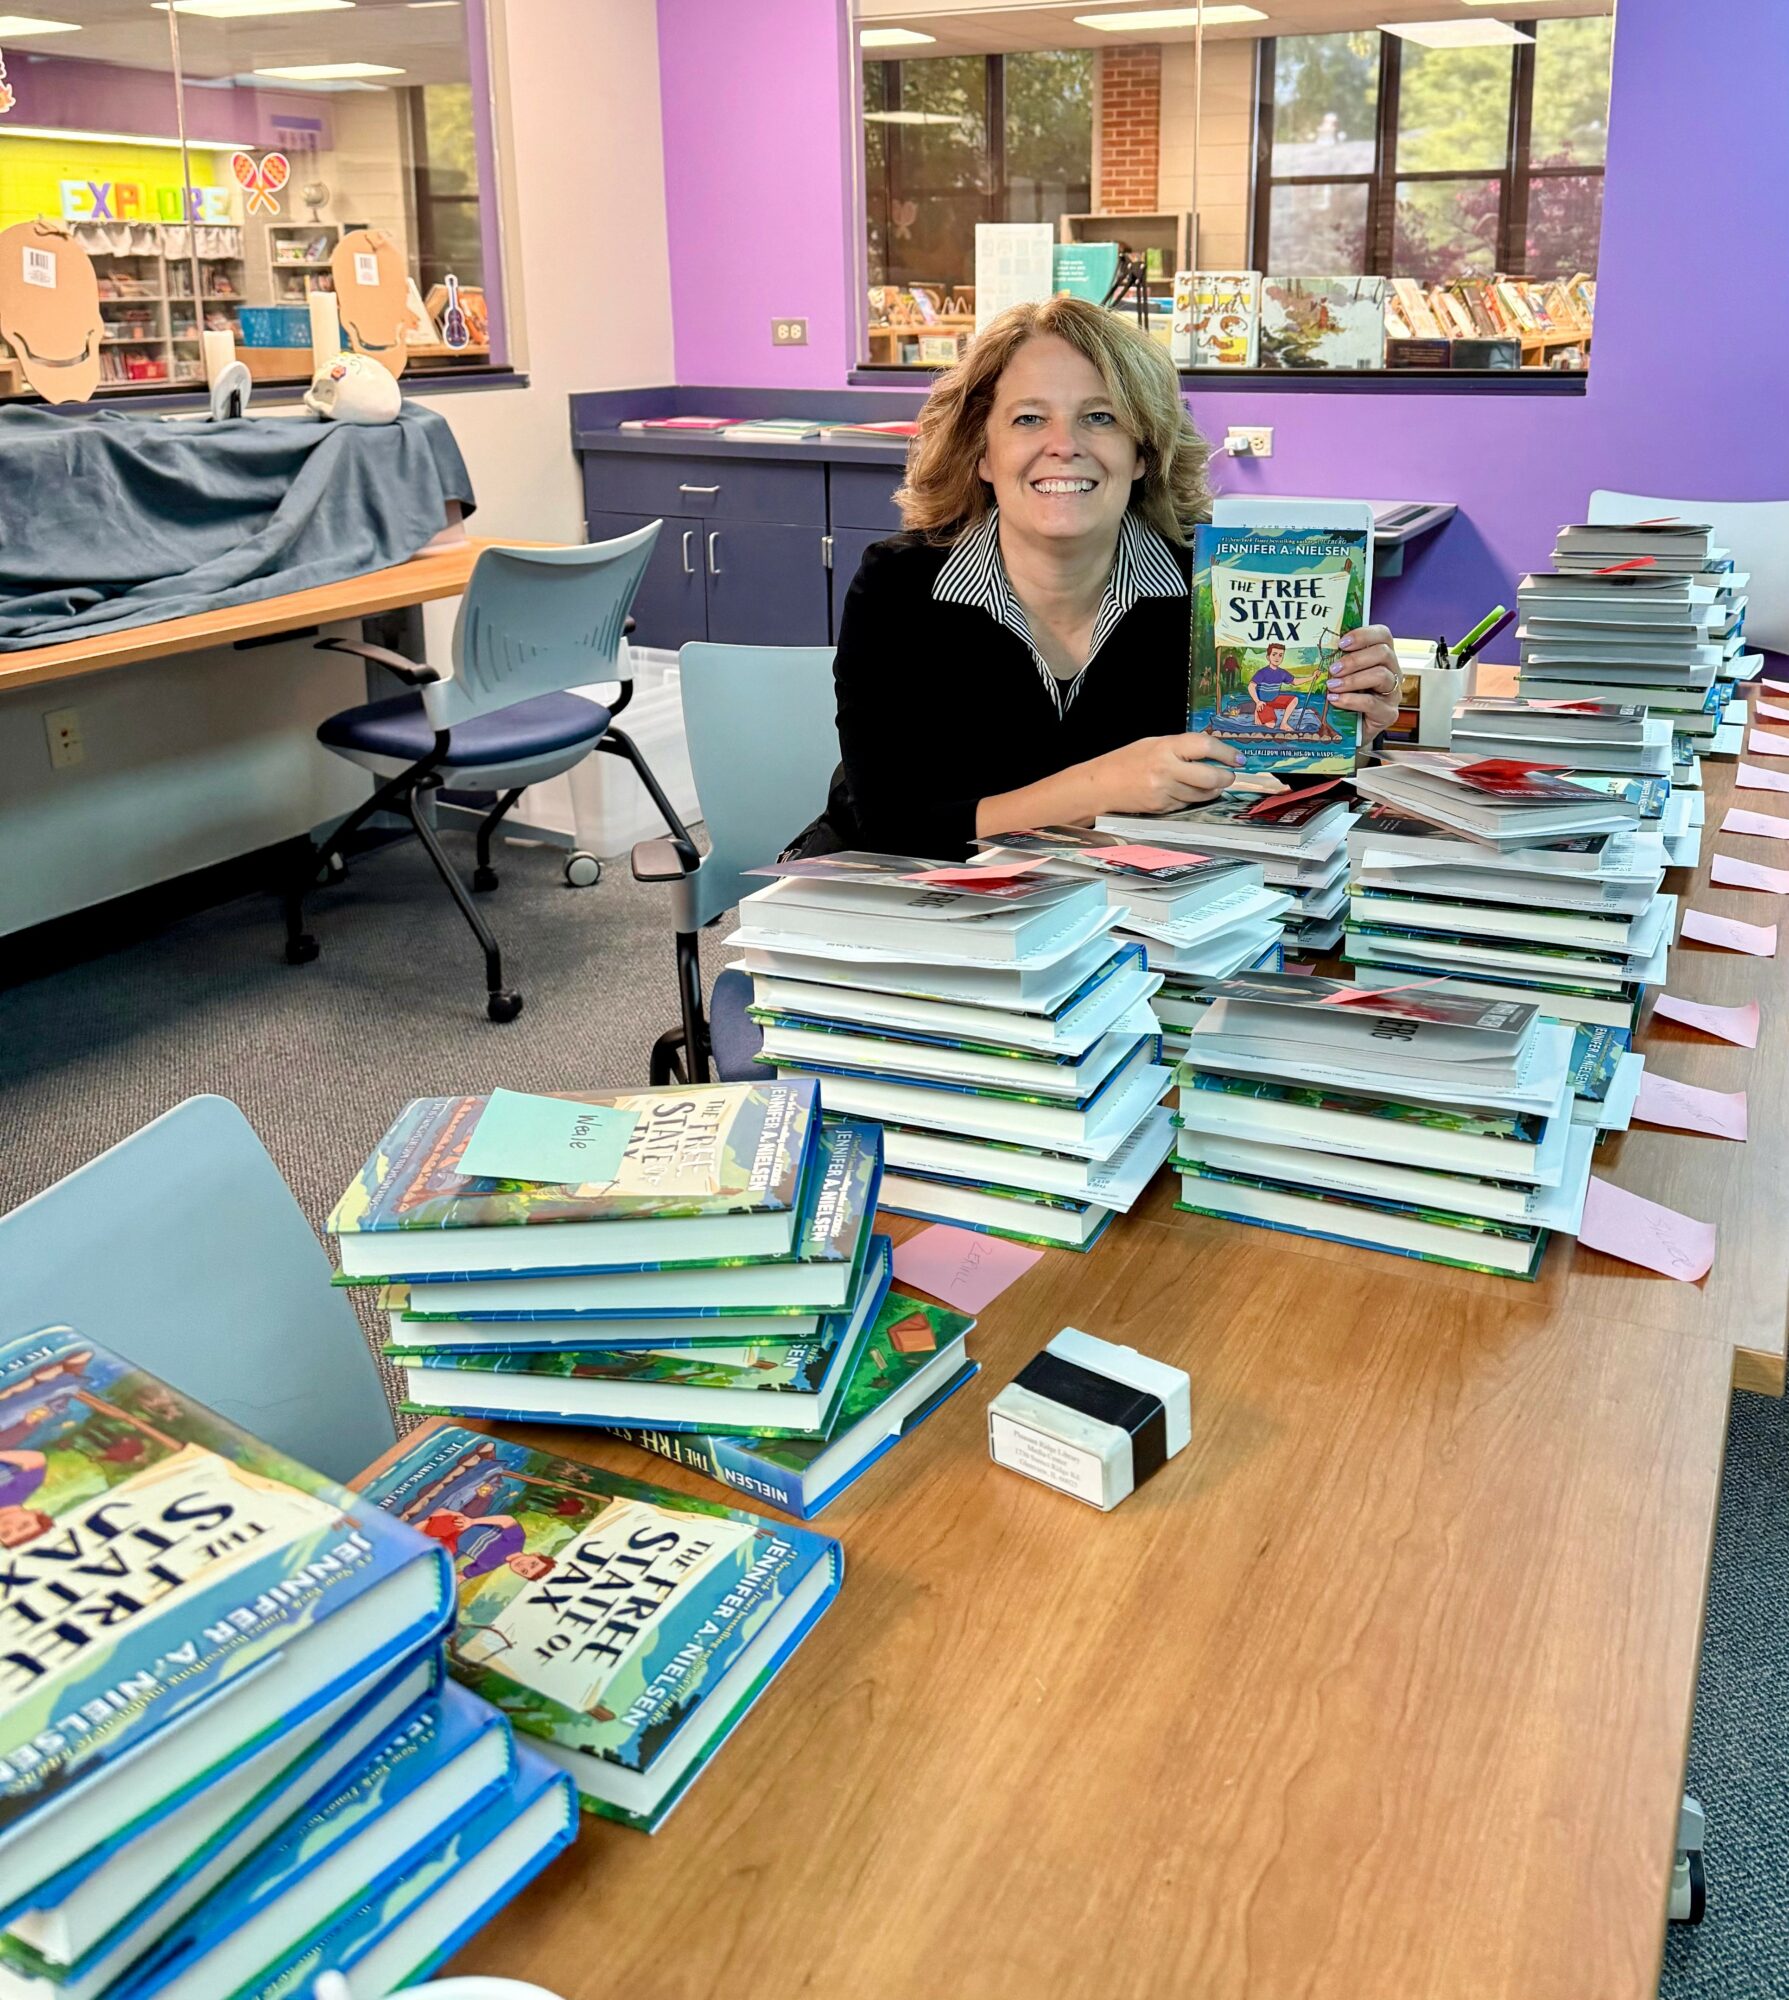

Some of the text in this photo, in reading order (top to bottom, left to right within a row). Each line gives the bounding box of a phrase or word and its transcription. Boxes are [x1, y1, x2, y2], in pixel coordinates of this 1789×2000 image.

[1216, 543, 1350, 556] JENNIFER A. NIELSEN
[1229, 577, 1327, 599] THE FREE
[1229, 597, 1334, 623] STATE OF
[1248, 620, 1302, 642] JAX
[1587, 1025, 1608, 1053] JENNIFER
[1575, 1059, 1595, 1086] NIELSEN
[642, 1102, 696, 1165] STATE
[675, 1099, 726, 1178] THE FREE
[748, 1086, 789, 1192] JENNIFER A. NIELSEN
[808, 1130, 854, 1242] JENNIFER A. NIELSEN
[685, 1448, 710, 1473] THE
[724, 1467, 789, 1505] NIELSEN
[0, 1502, 140, 1600] JAX
[0, 1490, 235, 1637] STATE
[775, 1559, 791, 1574] New
[203, 1531, 373, 1644] JENNIFER
[527, 1541, 617, 1614] JAX
[535, 1526, 680, 1667] STATE OF
[745, 1592, 764, 1611] Times
[762, 1573, 778, 1591] York
[0, 1521, 274, 1694] THE FREE
[571, 1540, 715, 1668] THE FREE
[713, 1610, 749, 1649] bestselling
[622, 1537, 792, 1727] JENNIFER A. NIELSEN
